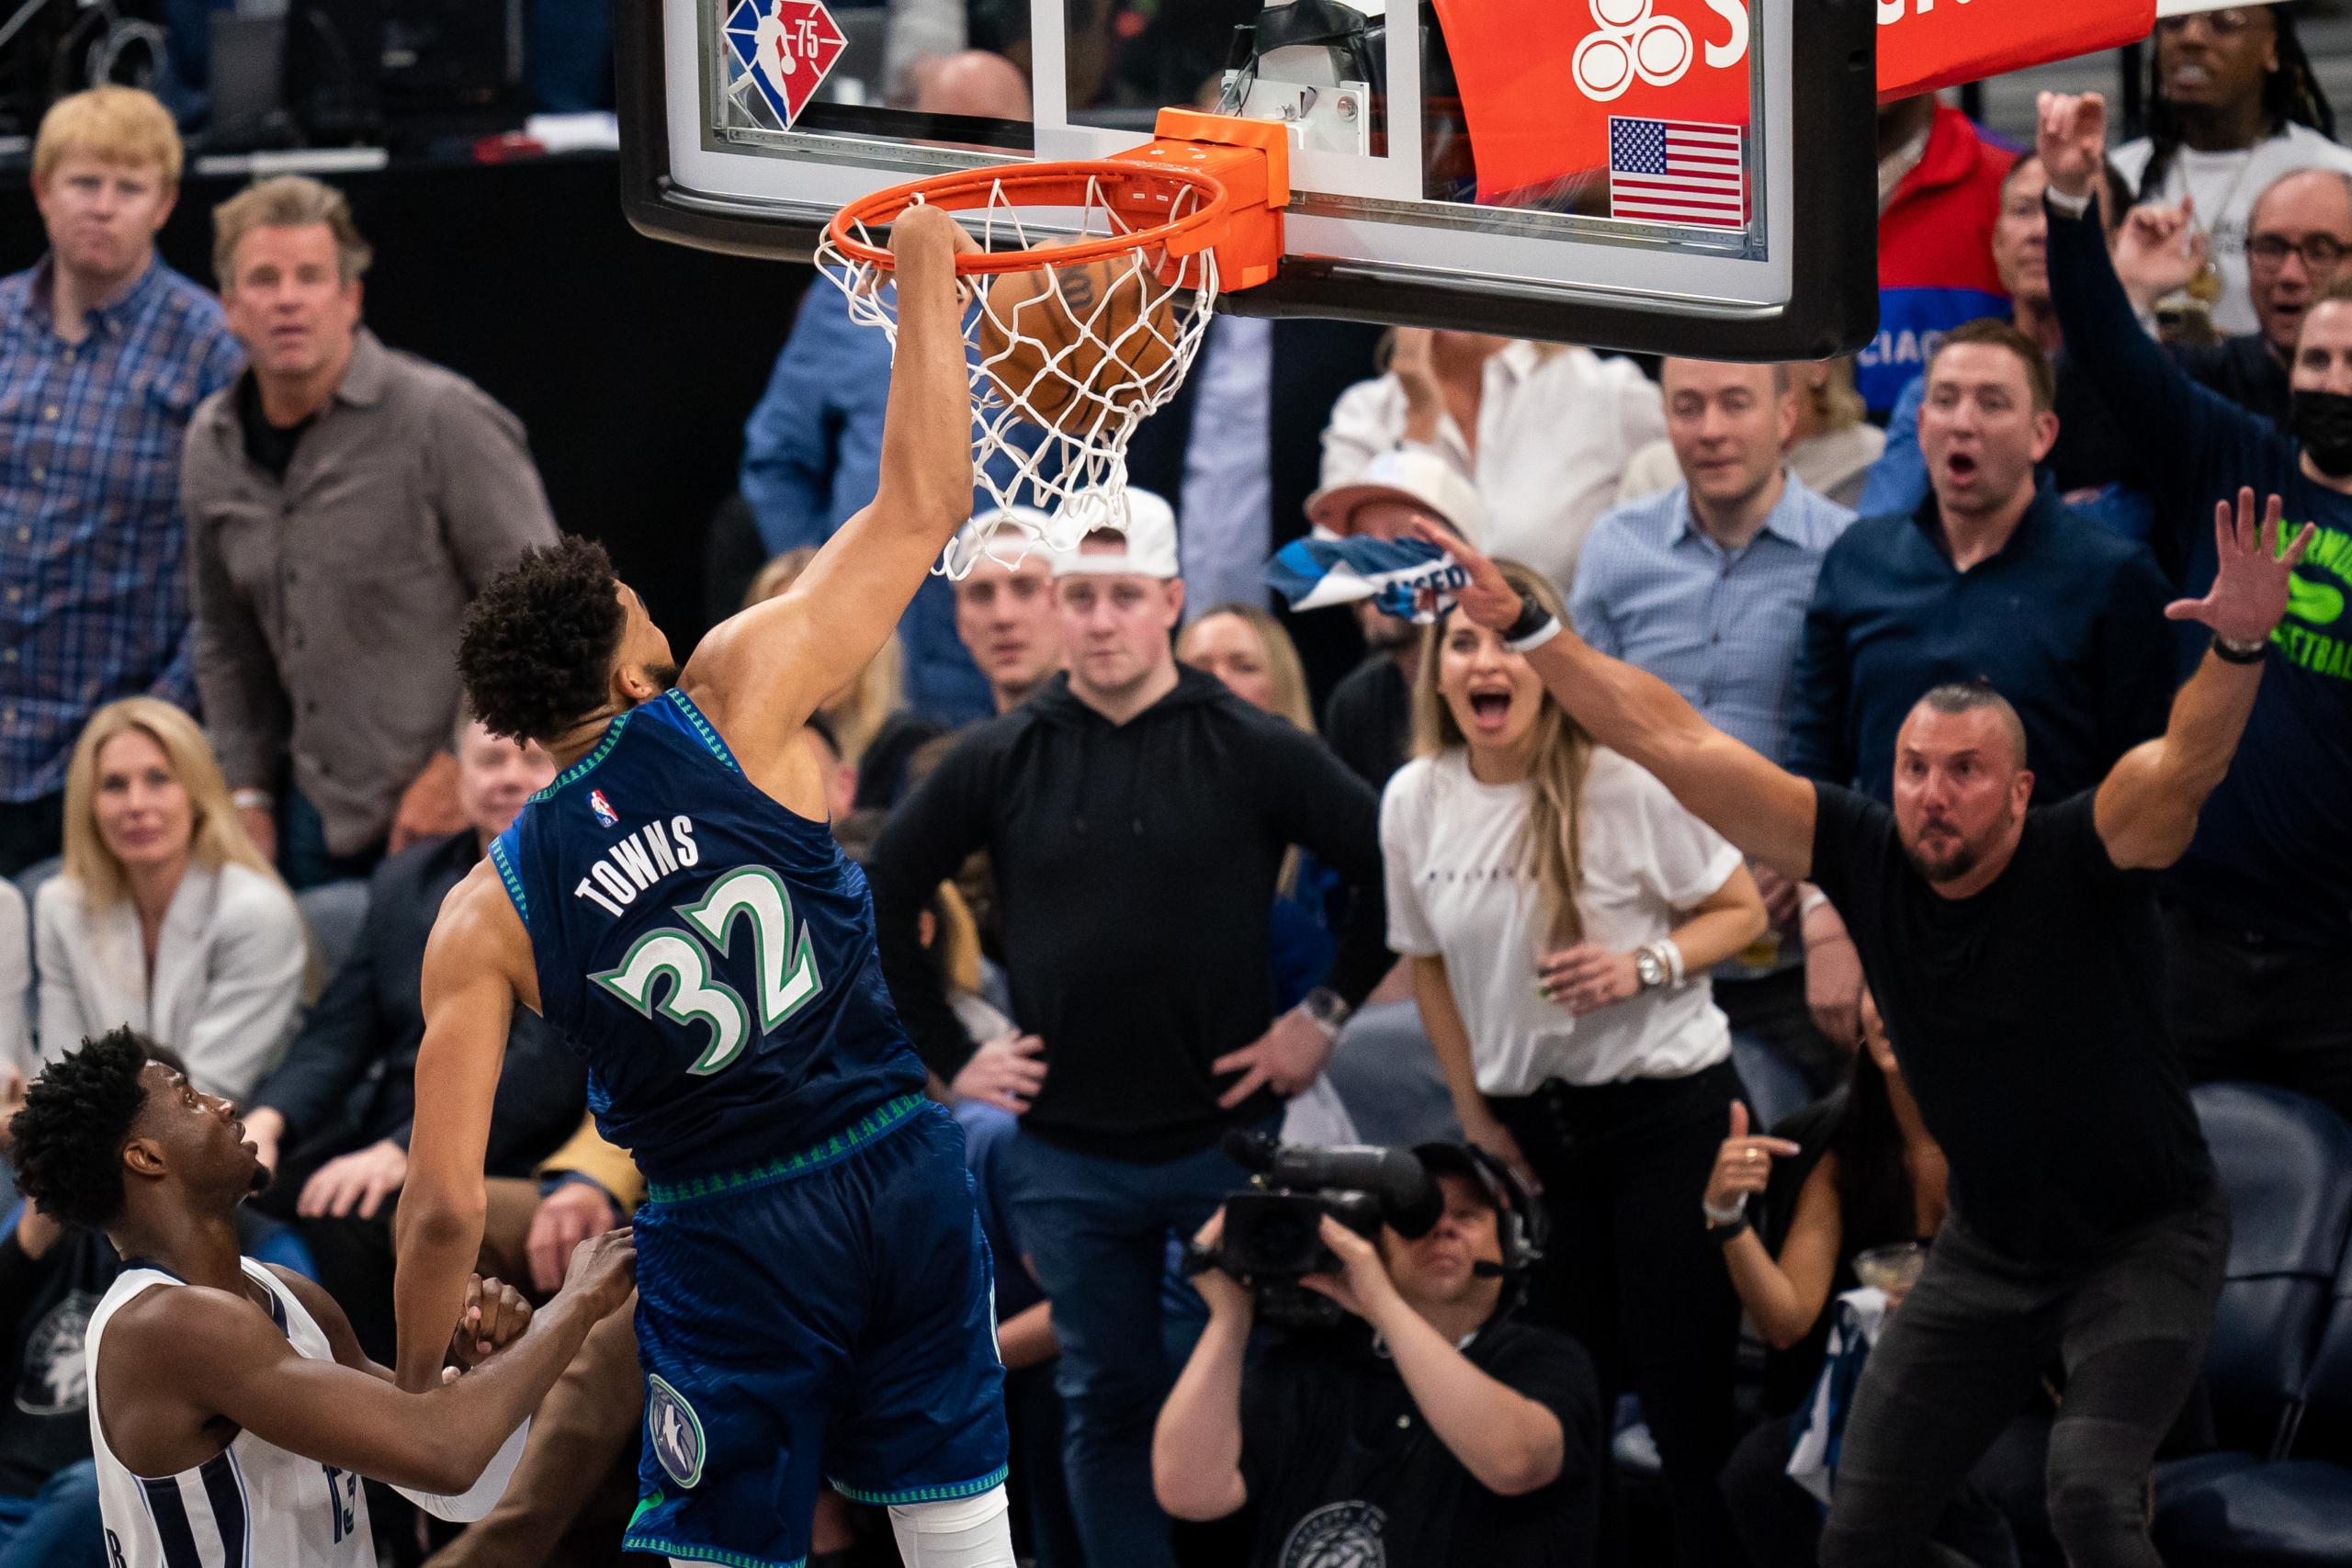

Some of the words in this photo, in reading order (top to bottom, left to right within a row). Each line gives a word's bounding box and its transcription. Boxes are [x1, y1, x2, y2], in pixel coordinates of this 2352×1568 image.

[795, 18, 819, 59] 75
[574, 815, 699, 918] TOWNS
[586, 863, 823, 1077] 32
